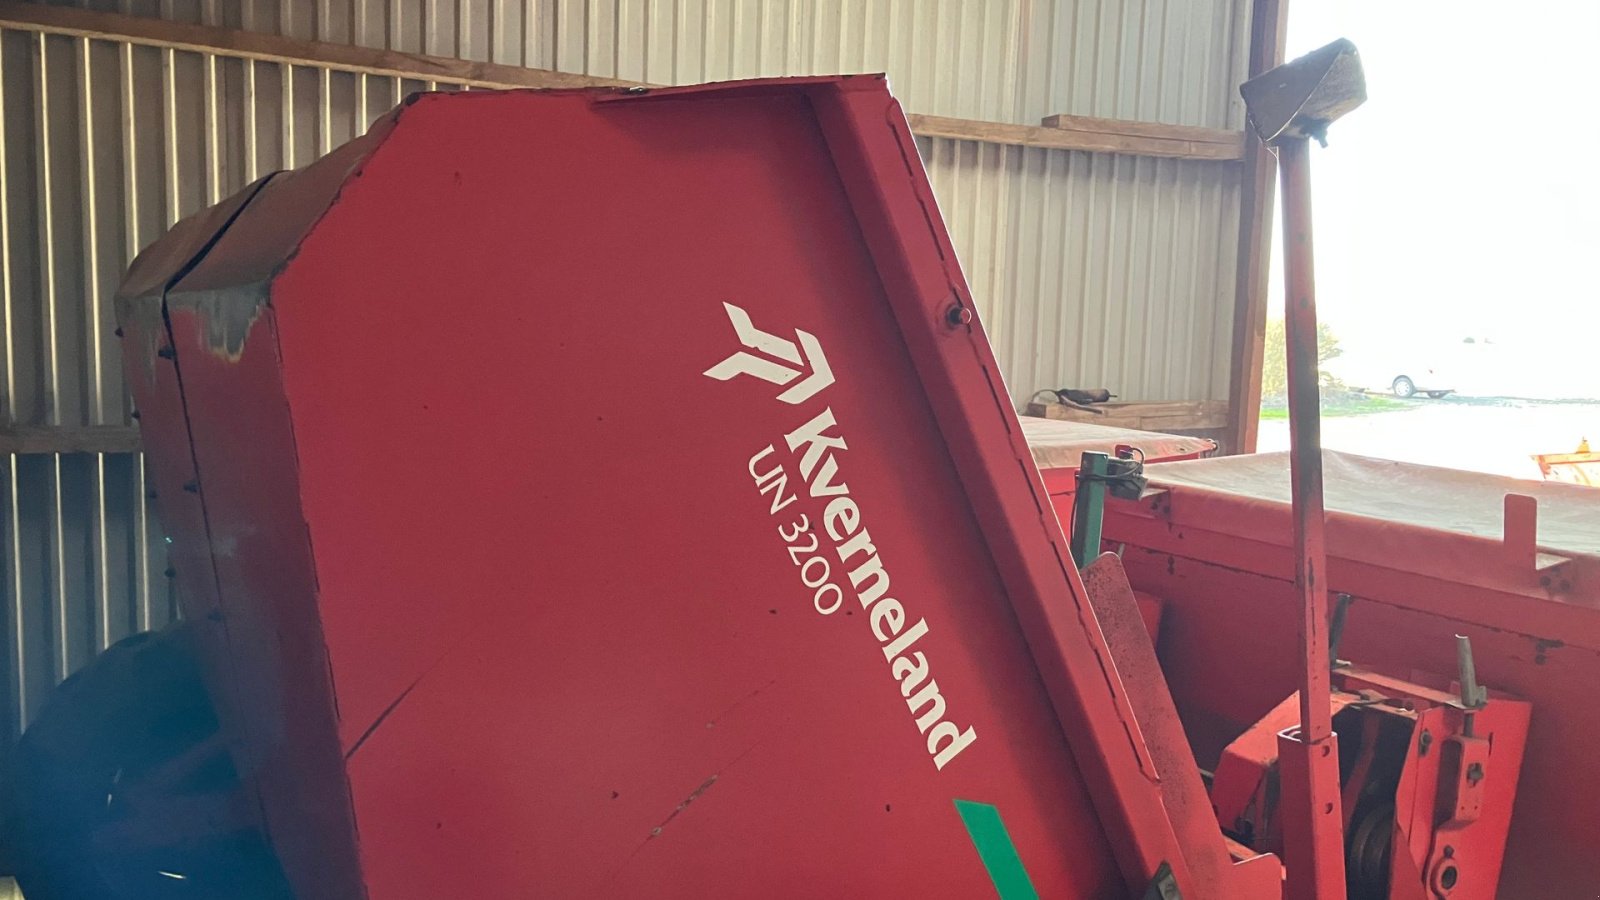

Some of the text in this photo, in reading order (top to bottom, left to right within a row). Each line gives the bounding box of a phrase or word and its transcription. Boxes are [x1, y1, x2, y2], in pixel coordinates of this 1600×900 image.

[748, 444, 843, 615] UN 3200
[784, 406, 977, 770] Kverneland
